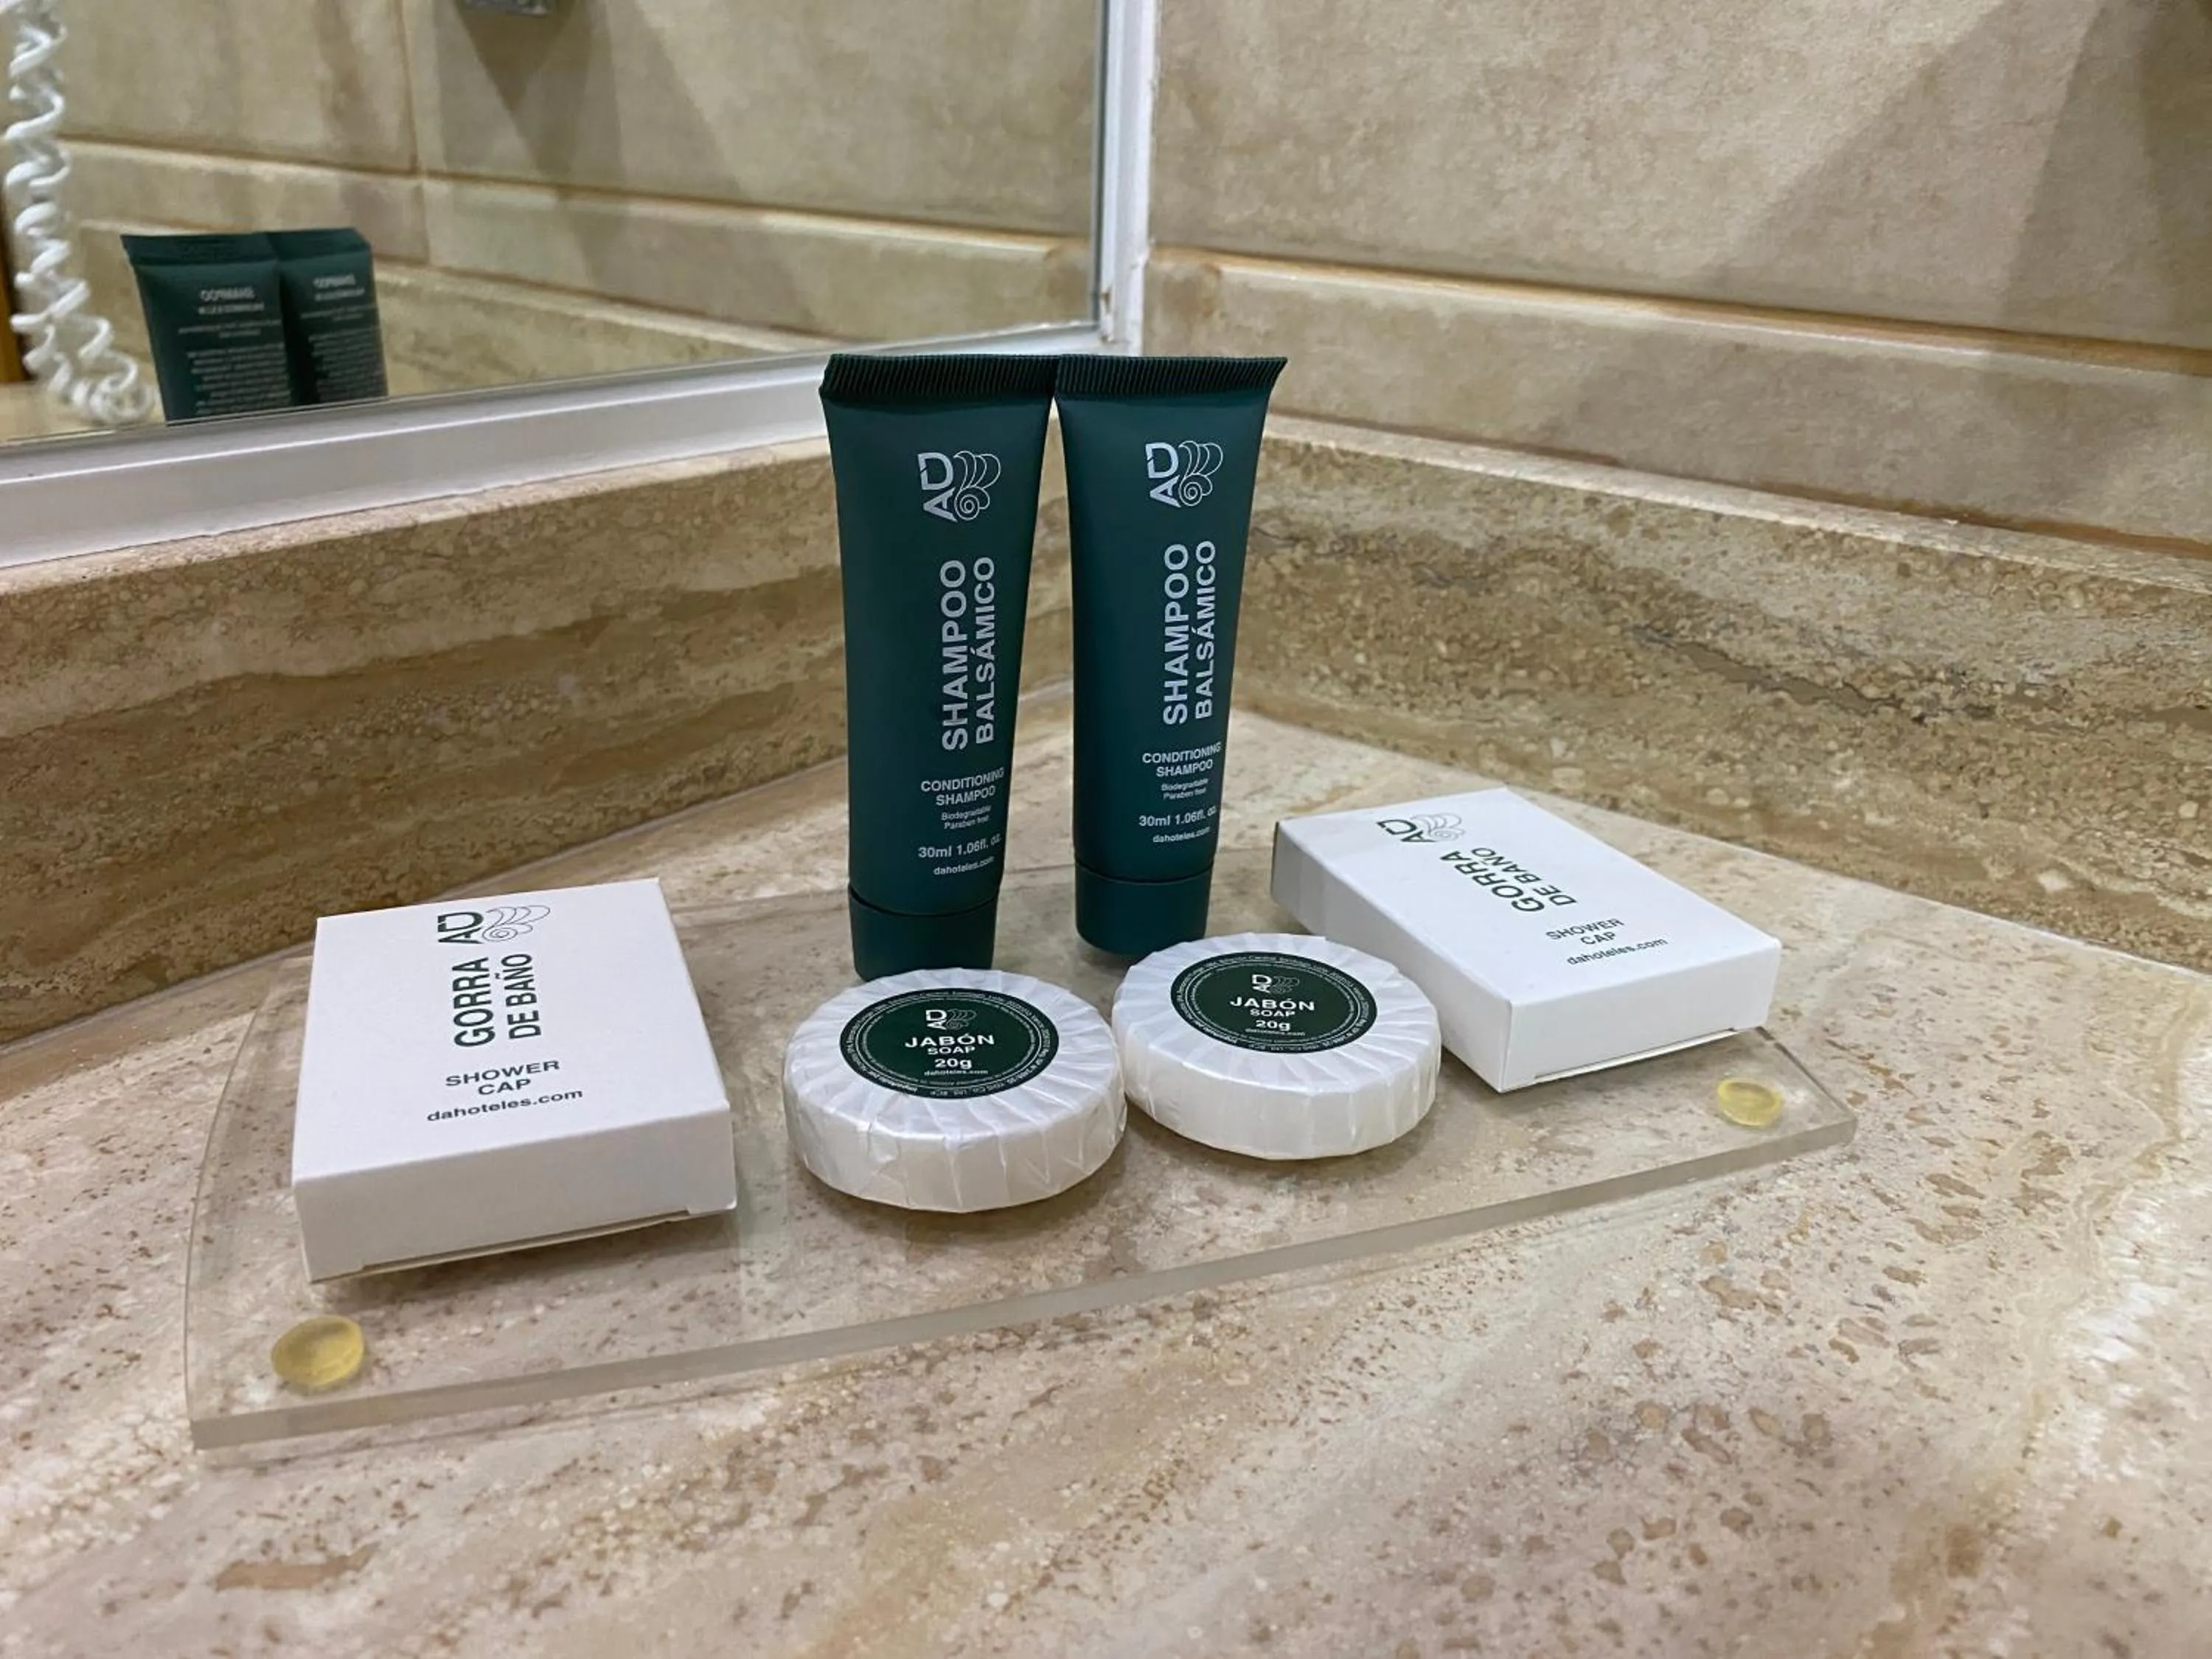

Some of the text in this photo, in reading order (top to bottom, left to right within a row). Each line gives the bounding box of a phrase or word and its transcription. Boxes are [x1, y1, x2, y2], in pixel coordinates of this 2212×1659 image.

[1163, 544, 1189, 725] SHAMPOO
[1192, 540, 1216, 719] BALSÁMICO
[940, 560, 968, 750] SHAMPOO
[970, 557, 995, 744] BALSÁMICO
[1142, 741, 1222, 763] CONDITIONING
[1156, 759, 1213, 777] SHAMPOO
[921, 767, 1005, 791] CONDITIONING
[936, 785, 996, 806] SHAMPOO
[1139, 815, 1170, 827] 30ml
[918, 846, 952, 858] 30ml
[933, 856, 994, 875] dahoteles.com
[1440, 851, 1545, 912] GORRA
[1532, 885, 1577, 905] DE
[1545, 918, 1625, 940] SHOWER
[1580, 931, 1616, 945] CAP
[1567, 939, 1669, 965] dahoteles.com
[451, 957, 495, 1047] GORRA
[494, 953, 542, 1040] DE BAÑO
[1230, 997, 1315, 1011] JABÓN
[1250, 1009, 1295, 1018] SOAP
[1256, 1020, 1290, 1032] 20g
[905, 1034, 995, 1048] JABÓN
[928, 1046, 975, 1055] SOAP
[445, 1060, 560, 1086] SHOWER
[935, 1058, 972, 1069] 20g
[479, 1079, 532, 1095] CAP
[427, 1091, 583, 1121] dahoteles.com
